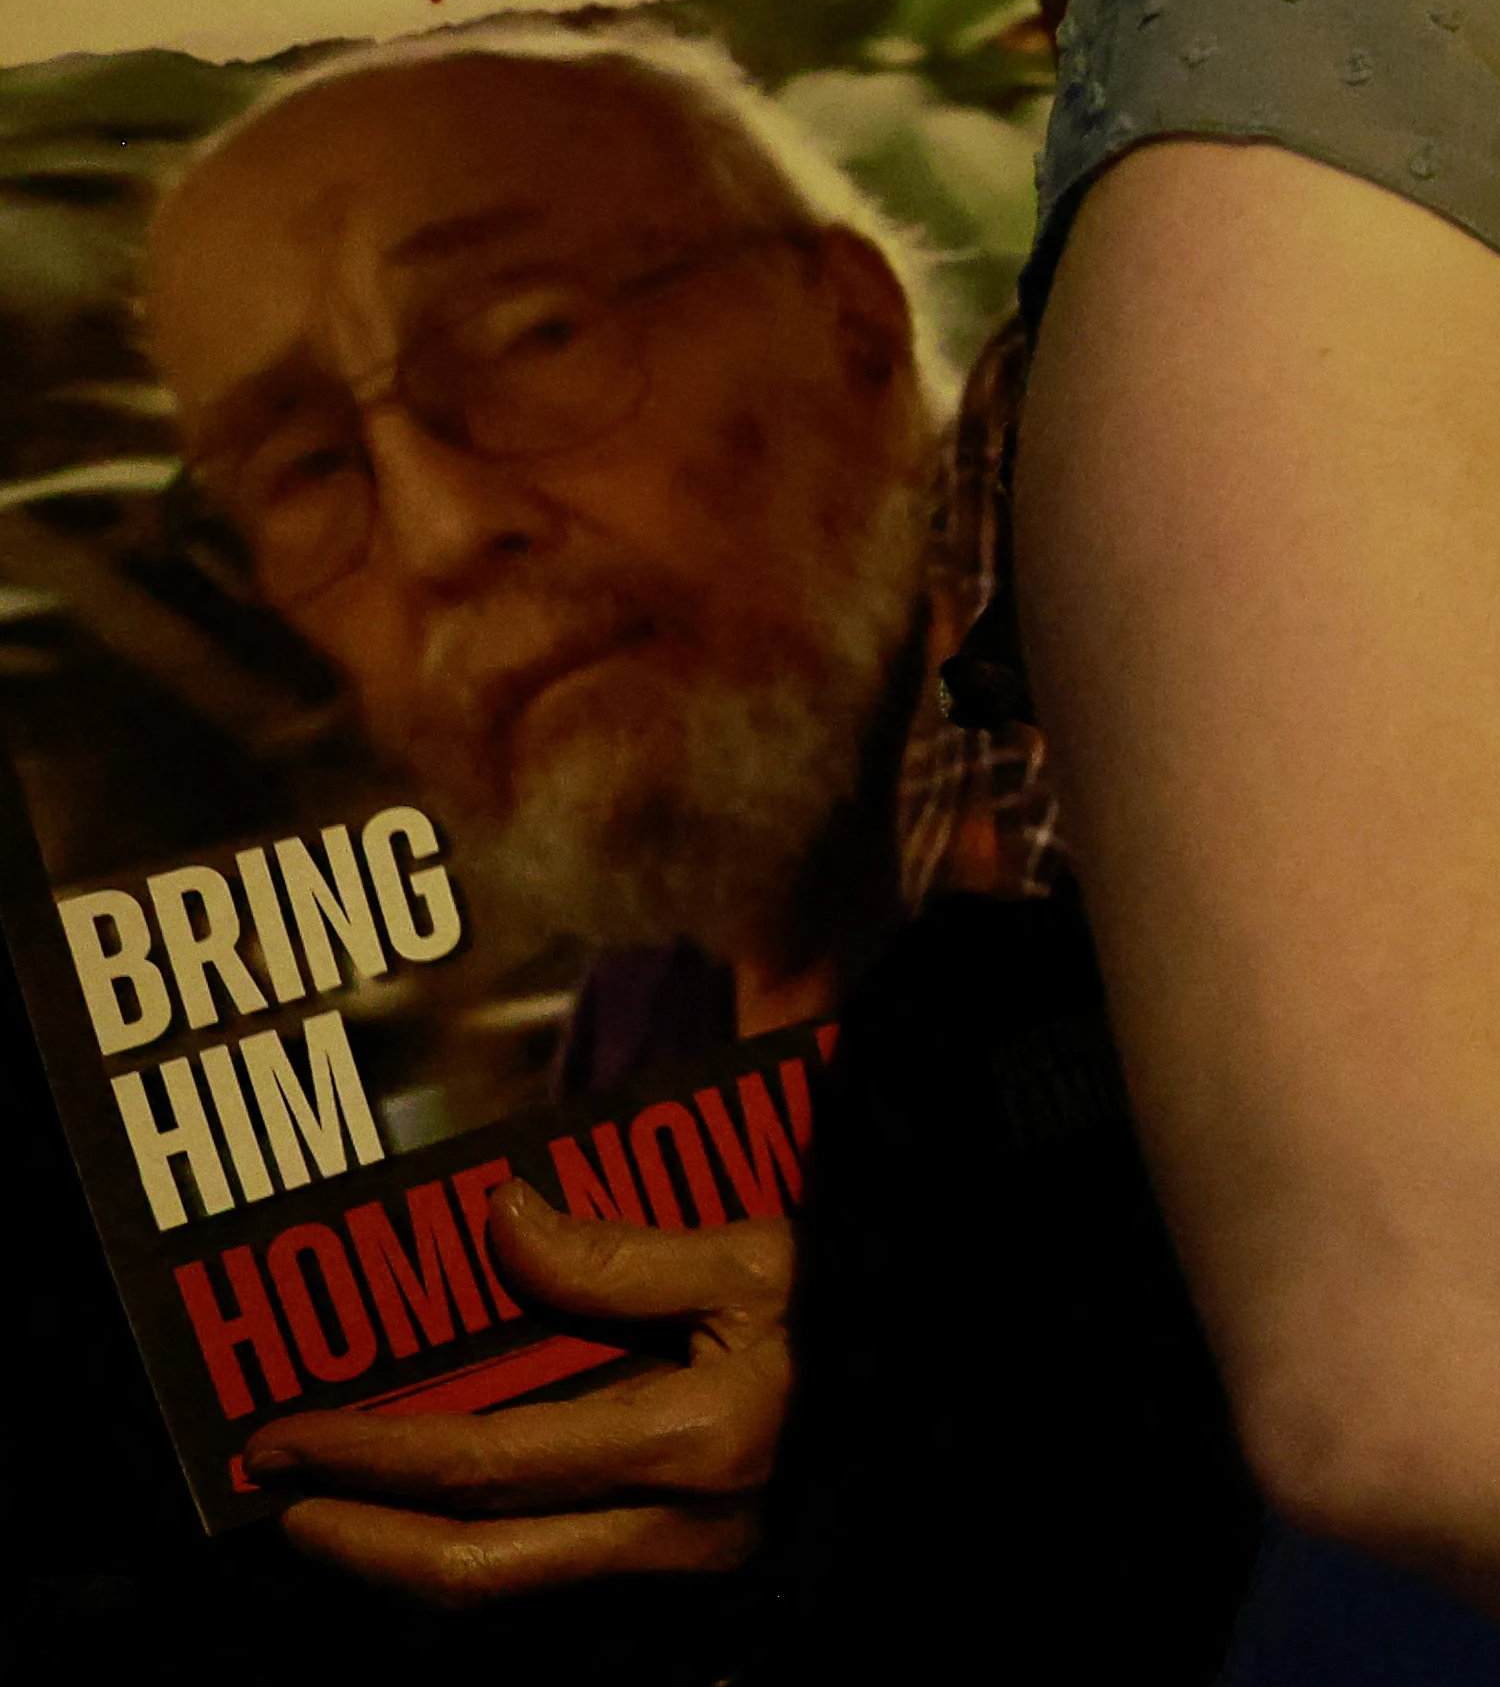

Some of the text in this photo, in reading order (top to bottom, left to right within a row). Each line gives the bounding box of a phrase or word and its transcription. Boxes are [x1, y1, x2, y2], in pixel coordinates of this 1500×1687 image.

[56, 806, 462, 1056] BRING
[111, 1009, 385, 1232] HIM
[548, 1023, 841, 1230] NOW
